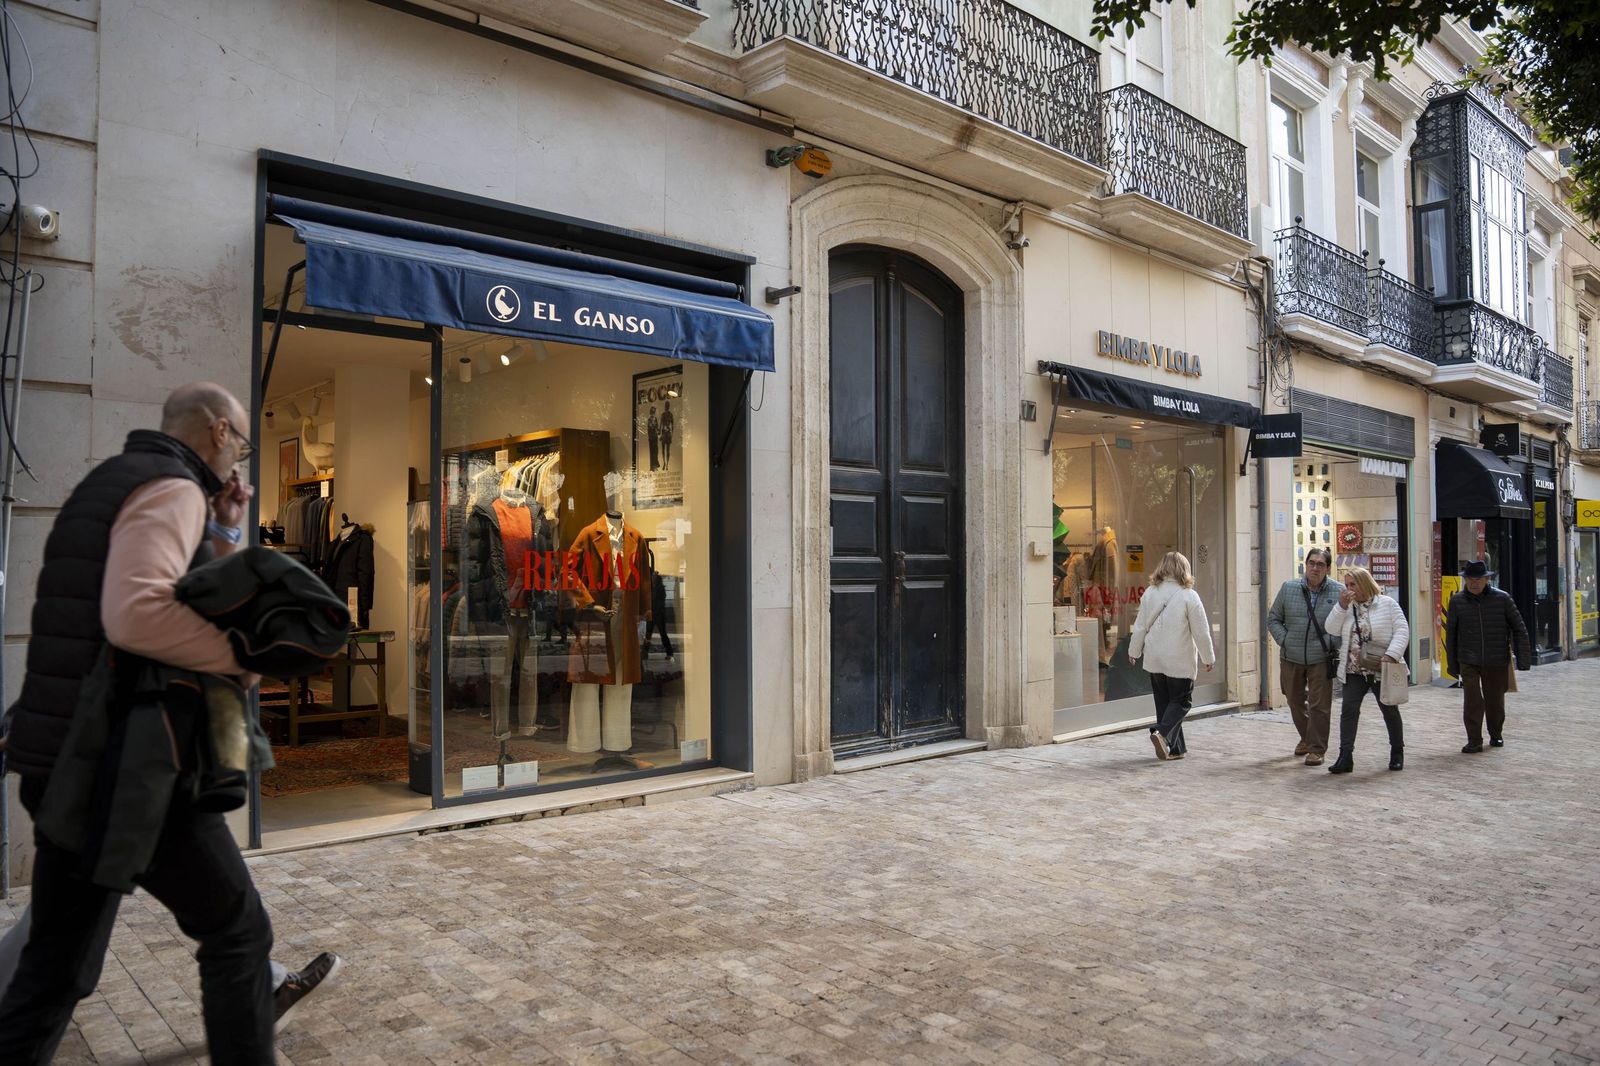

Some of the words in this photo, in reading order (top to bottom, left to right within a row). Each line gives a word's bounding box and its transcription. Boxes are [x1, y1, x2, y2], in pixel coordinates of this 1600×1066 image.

[533, 301, 562, 322] EL
[573, 306, 655, 335] GANSO
[1097, 330, 1151, 365] BIMBA
[1151, 343, 1165, 368] Y
[1164, 347, 1202, 376] LOLA
[1153, 394, 1175, 411] BIMBA
[1182, 399, 1200, 414] LOLA
[523, 549, 641, 591] REBAJAS
[1372, 556, 1396, 564] REBAJAS
